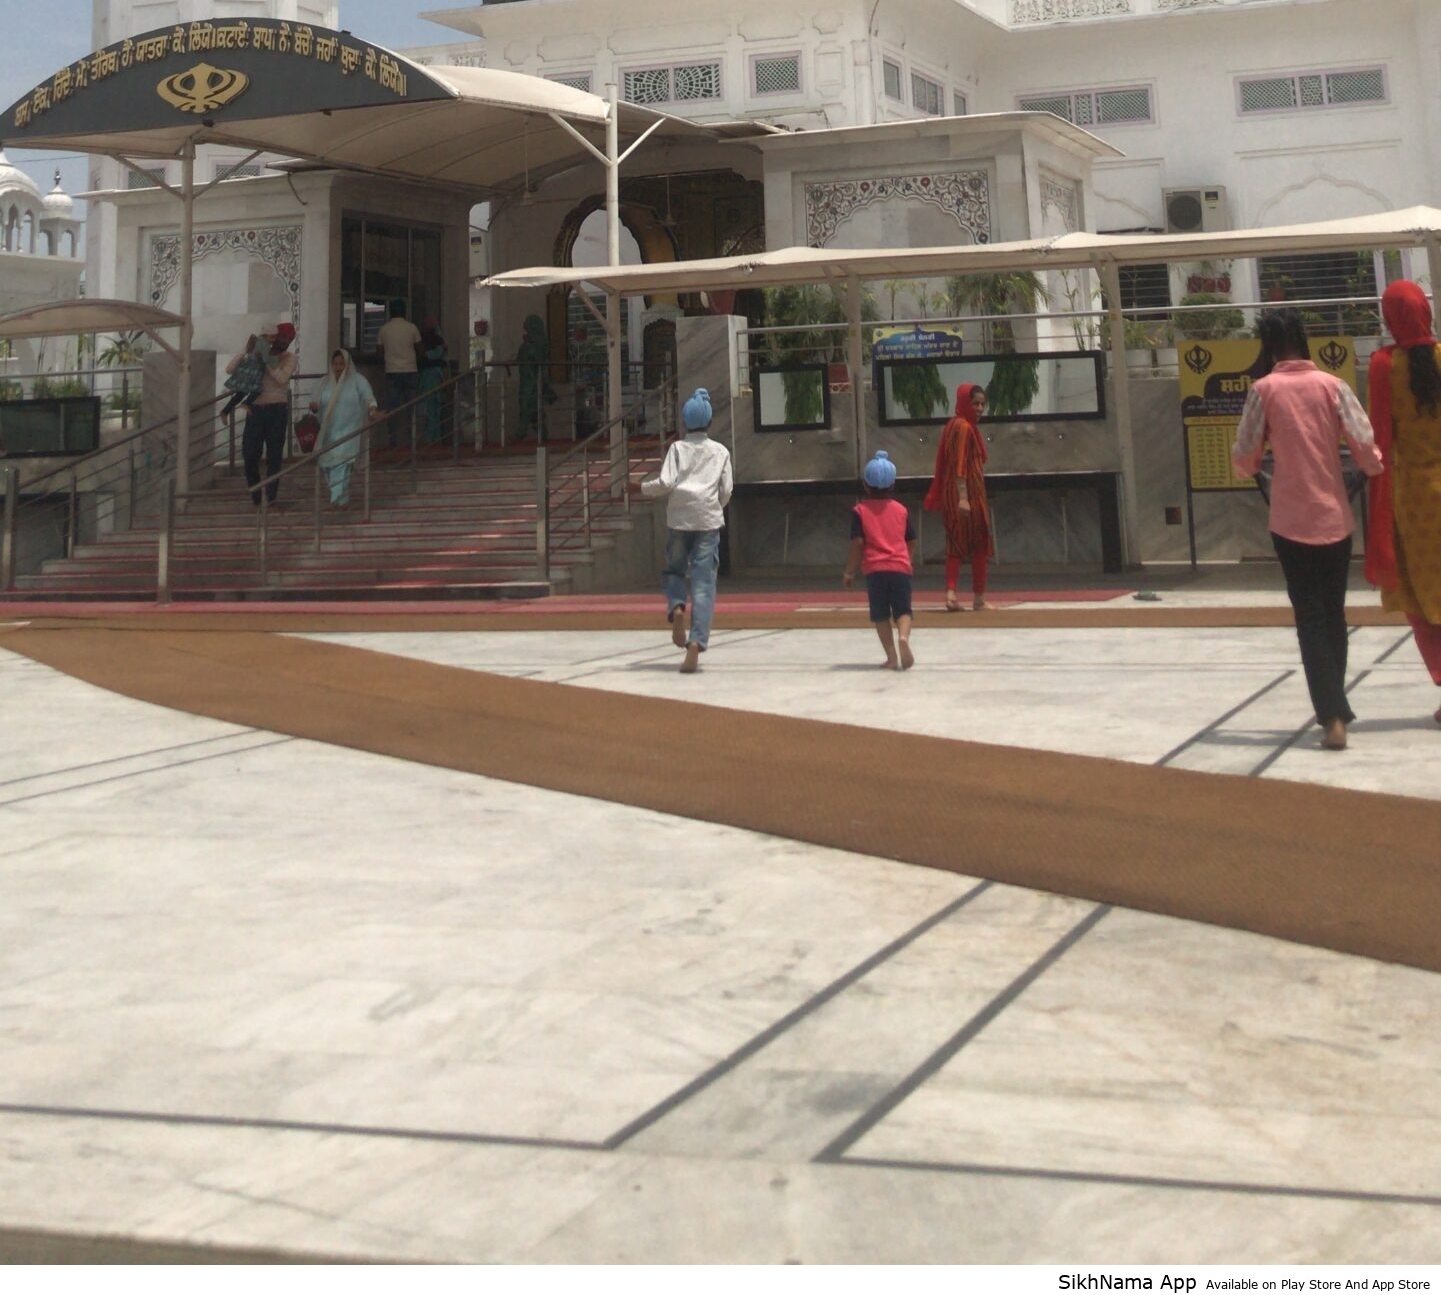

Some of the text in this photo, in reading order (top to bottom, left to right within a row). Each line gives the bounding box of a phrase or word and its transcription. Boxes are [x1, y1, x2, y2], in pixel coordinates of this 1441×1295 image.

[133, 34, 170, 62] ਯਾਤਰਾ
[253, 26, 277, 51] ਬਾਪ
[279, 22, 292, 52] ਨੇ
